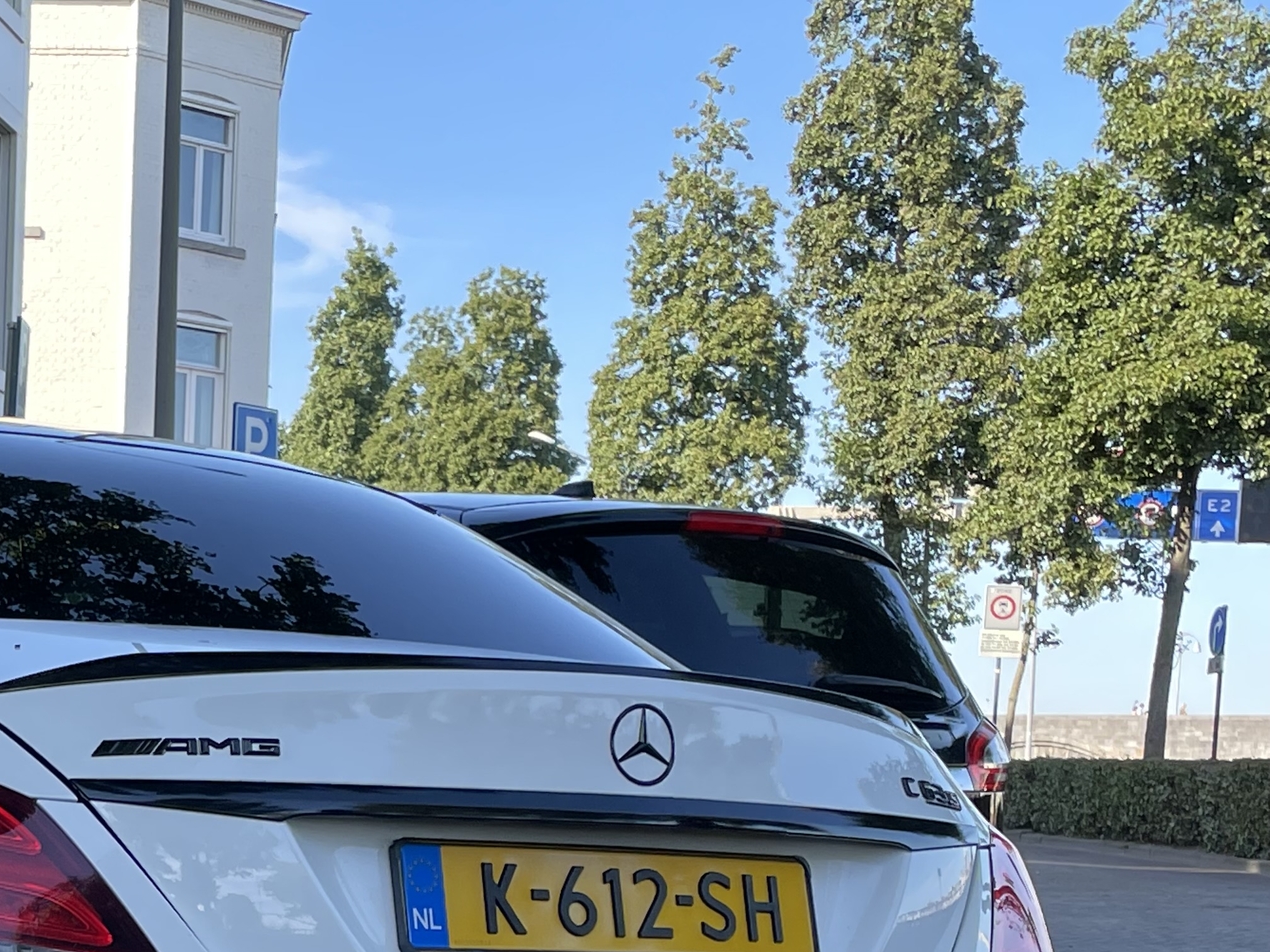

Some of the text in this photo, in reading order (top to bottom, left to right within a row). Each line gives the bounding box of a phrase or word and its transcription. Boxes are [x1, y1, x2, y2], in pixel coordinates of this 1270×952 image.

[245, 415, 269, 454] P
[1207, 498, 1231, 513] E2
[151, 737, 281, 757] AMG
[480, 861, 784, 944] K-612-SH
[411, 908, 443, 931] NL
